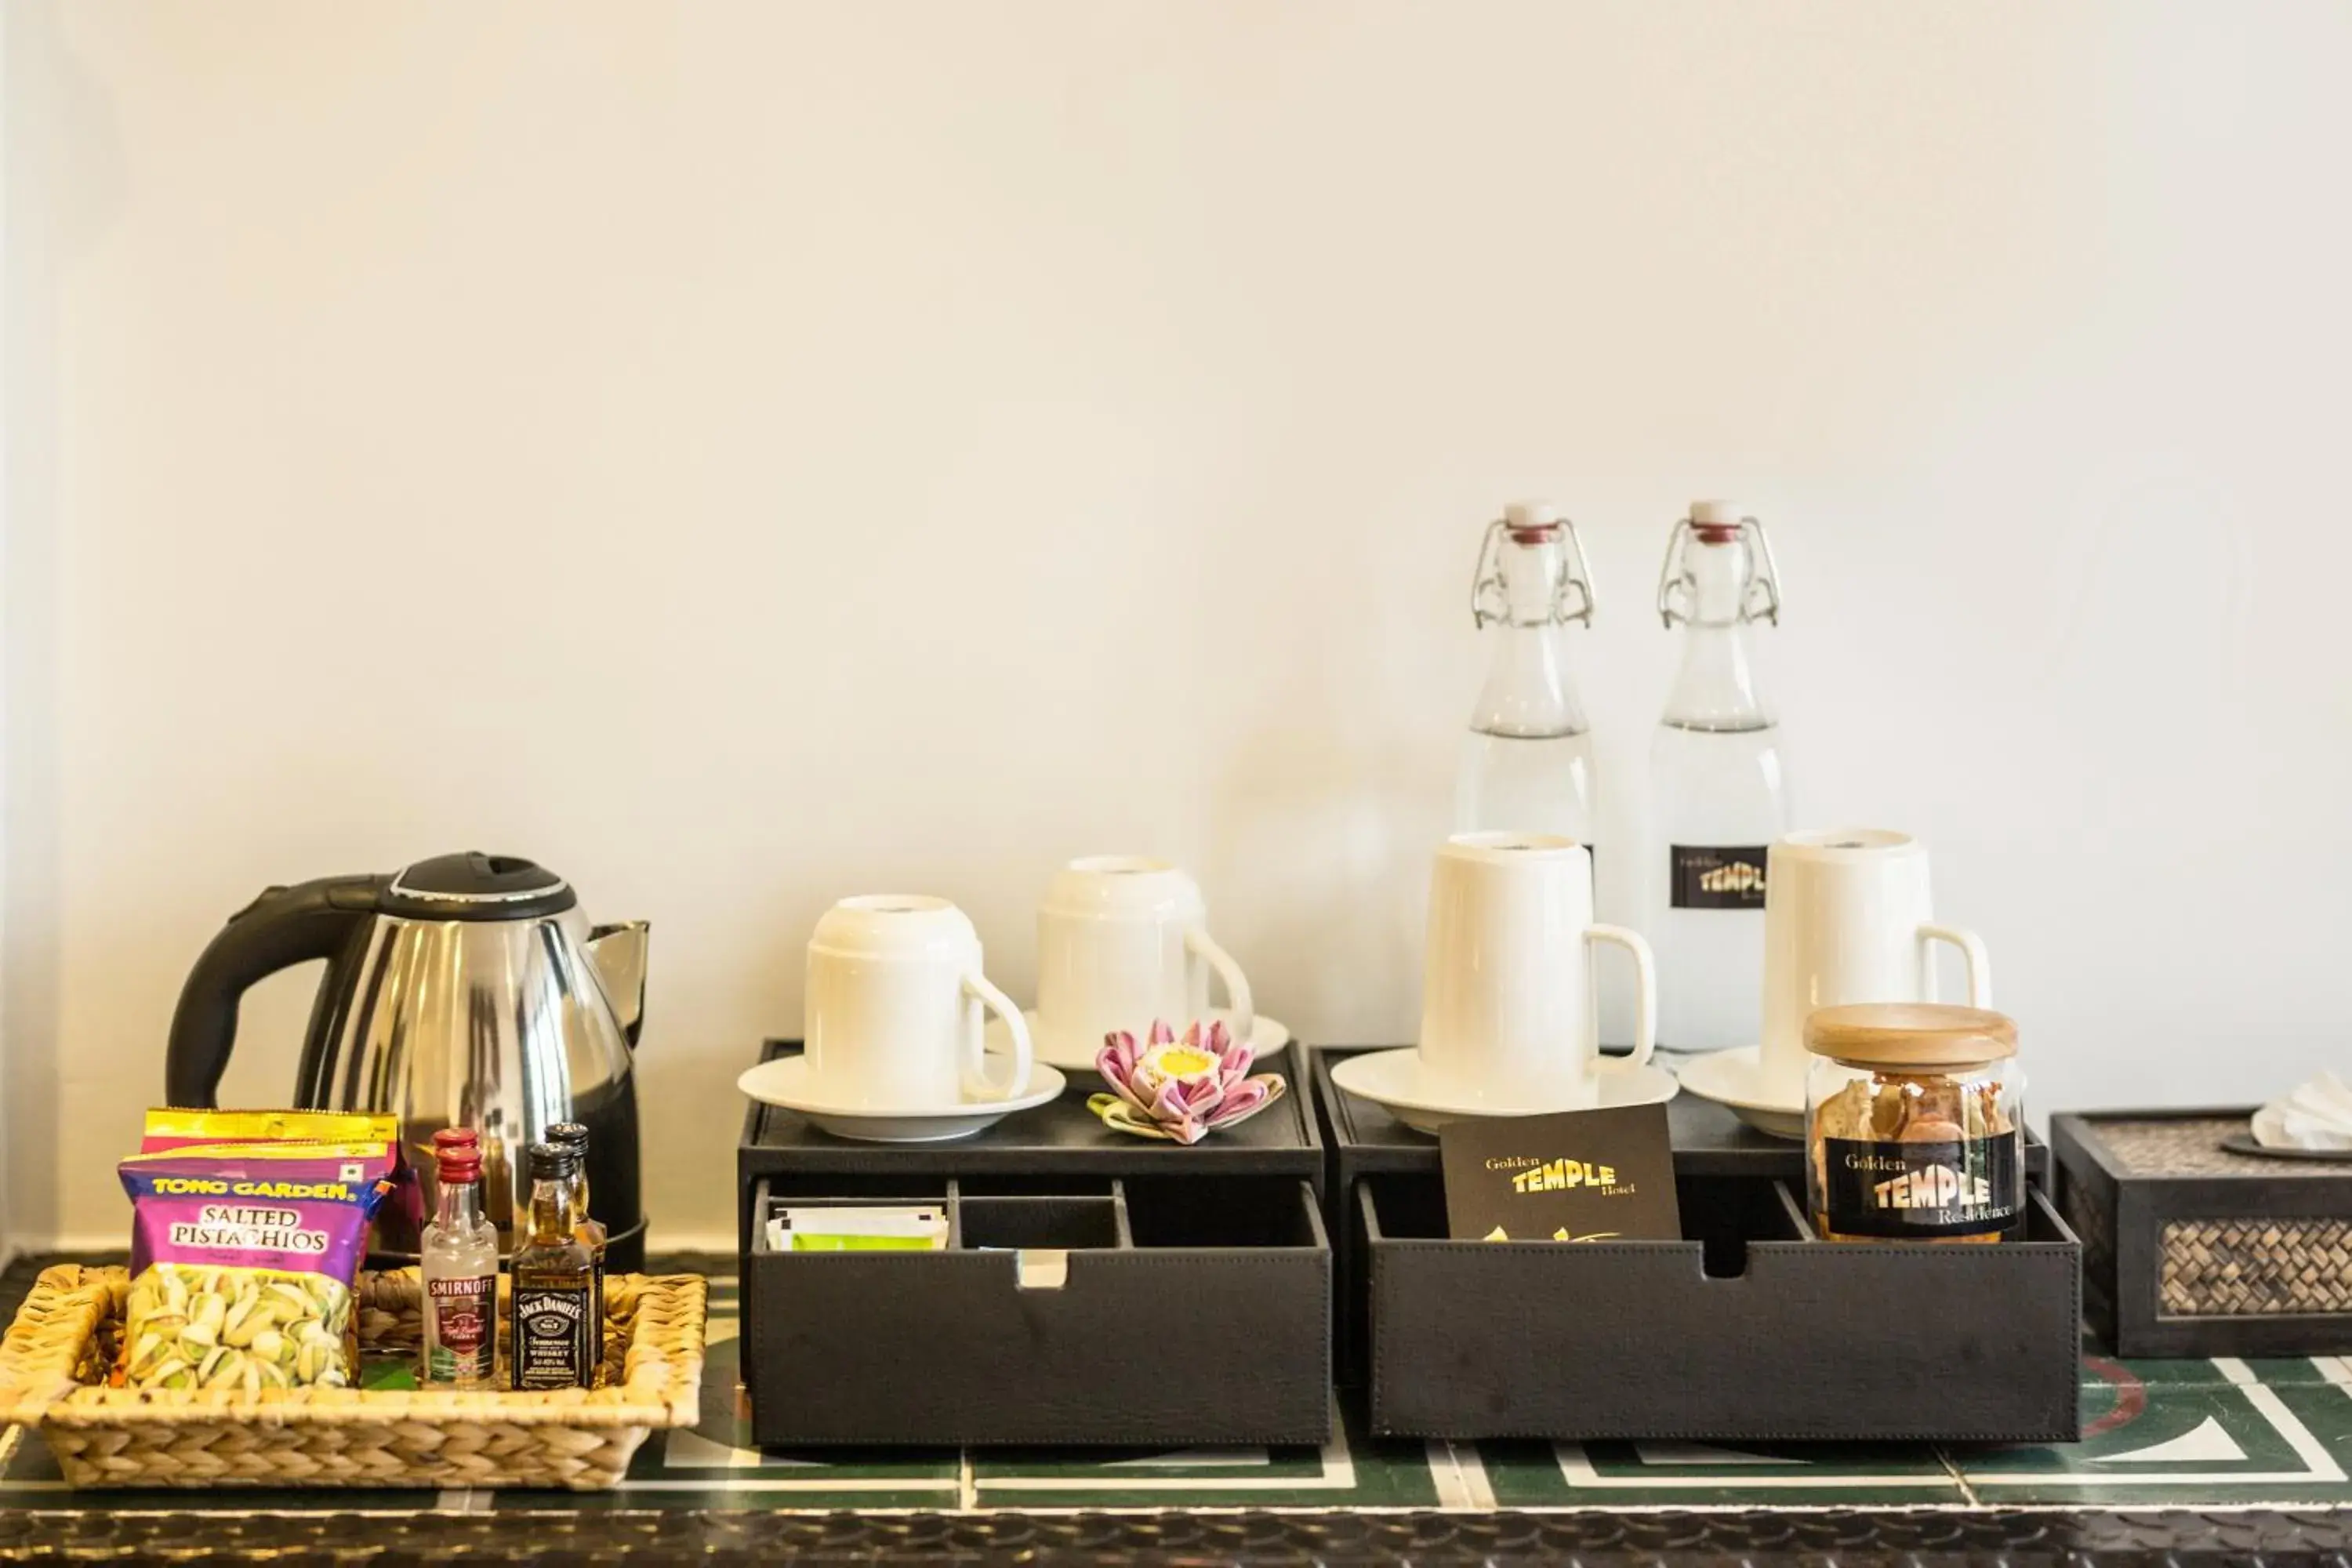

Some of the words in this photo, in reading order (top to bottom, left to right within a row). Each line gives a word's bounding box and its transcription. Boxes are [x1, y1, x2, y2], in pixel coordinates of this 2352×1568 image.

[1699, 861, 1766, 891] TEMPL
[1486, 1156, 1540, 1171] Golden
[1845, 1153, 1906, 1171] Golden
[1512, 1158, 1617, 1193] TEMPLE
[1875, 1163, 1991, 1208] TEMPLE
[152, 1178, 228, 1195] TONG
[233, 1181, 347, 1200] GARDEN
[1601, 1183, 1635, 1196] Hotel
[204, 1207, 298, 1228] SALTED
[1938, 1205, 2013, 1225] Residence
[174, 1225, 326, 1251] PISTACHIOS
[430, 1279, 492, 1297] SMIRNOFF
[519, 1300, 543, 1319] JACK
[543, 1296, 583, 1319] DANIEL'S
